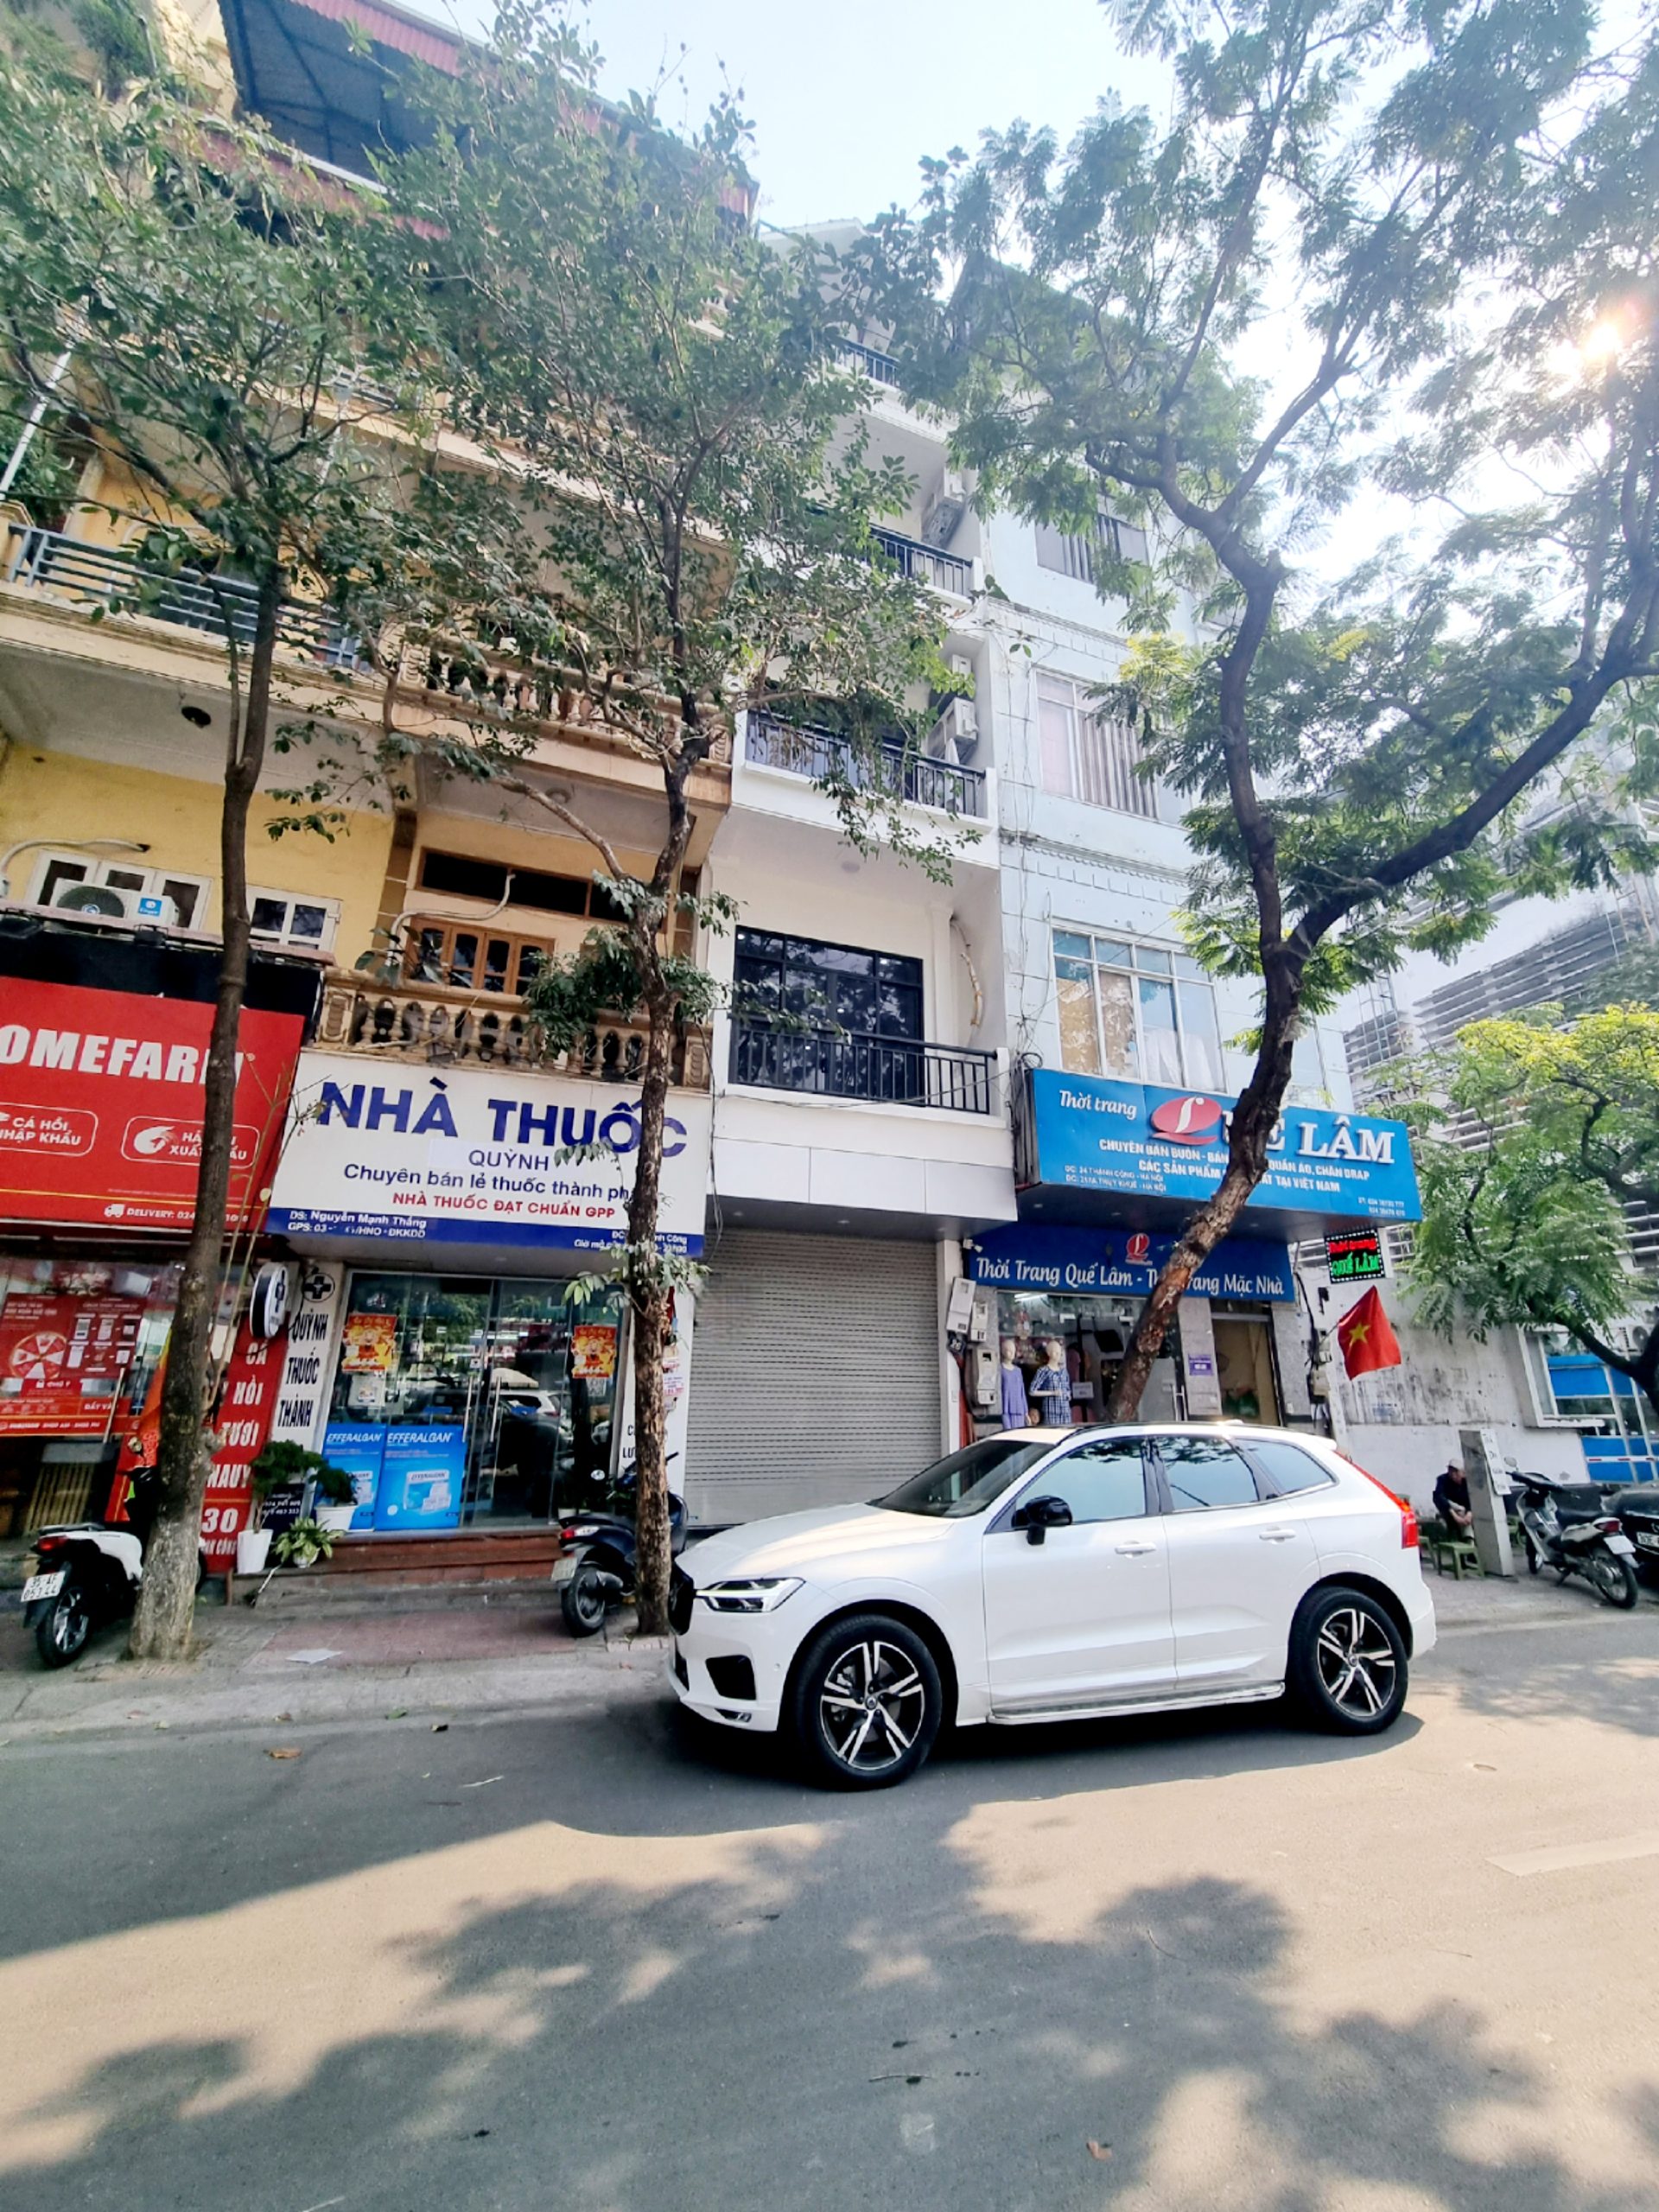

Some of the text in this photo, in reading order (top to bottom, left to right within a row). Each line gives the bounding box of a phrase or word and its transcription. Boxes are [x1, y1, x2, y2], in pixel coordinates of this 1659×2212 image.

[316, 1077, 687, 1158] NHÀ THUỐC
[1059, 1090, 1137, 1121] Thời trang
[13, 1116, 35, 1128] CÁ
[1099, 1139, 1144, 1154] CHUYÊN
[1297, 1115, 1395, 1164] LÂM
[468, 1148, 549, 1172] QUỲNH
[344, 1164, 421, 1186] Chuyên
[428, 1171, 463, 1188] bán
[470, 1173, 486, 1189] lẻ
[493, 1176, 546, 1193] thuốc
[552, 1180, 602, 1198] thành
[1138, 1159, 1161, 1173] CÁC
[1316, 1181, 1340, 1192] NAM
[310, 1210, 355, 1224] Nguyễn
[358, 1214, 389, 1225] Mạnh
[393, 1191, 615, 1218] NHÀ THUỐC ĐẠT CHUẨN GPP
[976, 1257, 1010, 1279] Thời
[1015, 1260, 1060, 1287] Trang
[1065, 1262, 1098, 1288] Quế
[1100, 1265, 1134, 1287] Lâm
[1187, 1276, 1220, 1296] rang
[1224, 1273, 1253, 1298] Mặc
[1255, 1275, 1285, 1295] Nhà
[277, 1394, 314, 1427] THÀNH
[327, 1433, 382, 1442] EFFERALGAN
[387, 1432, 453, 1443] EFFERALGAN
[201, 1507, 238, 1533] 30
